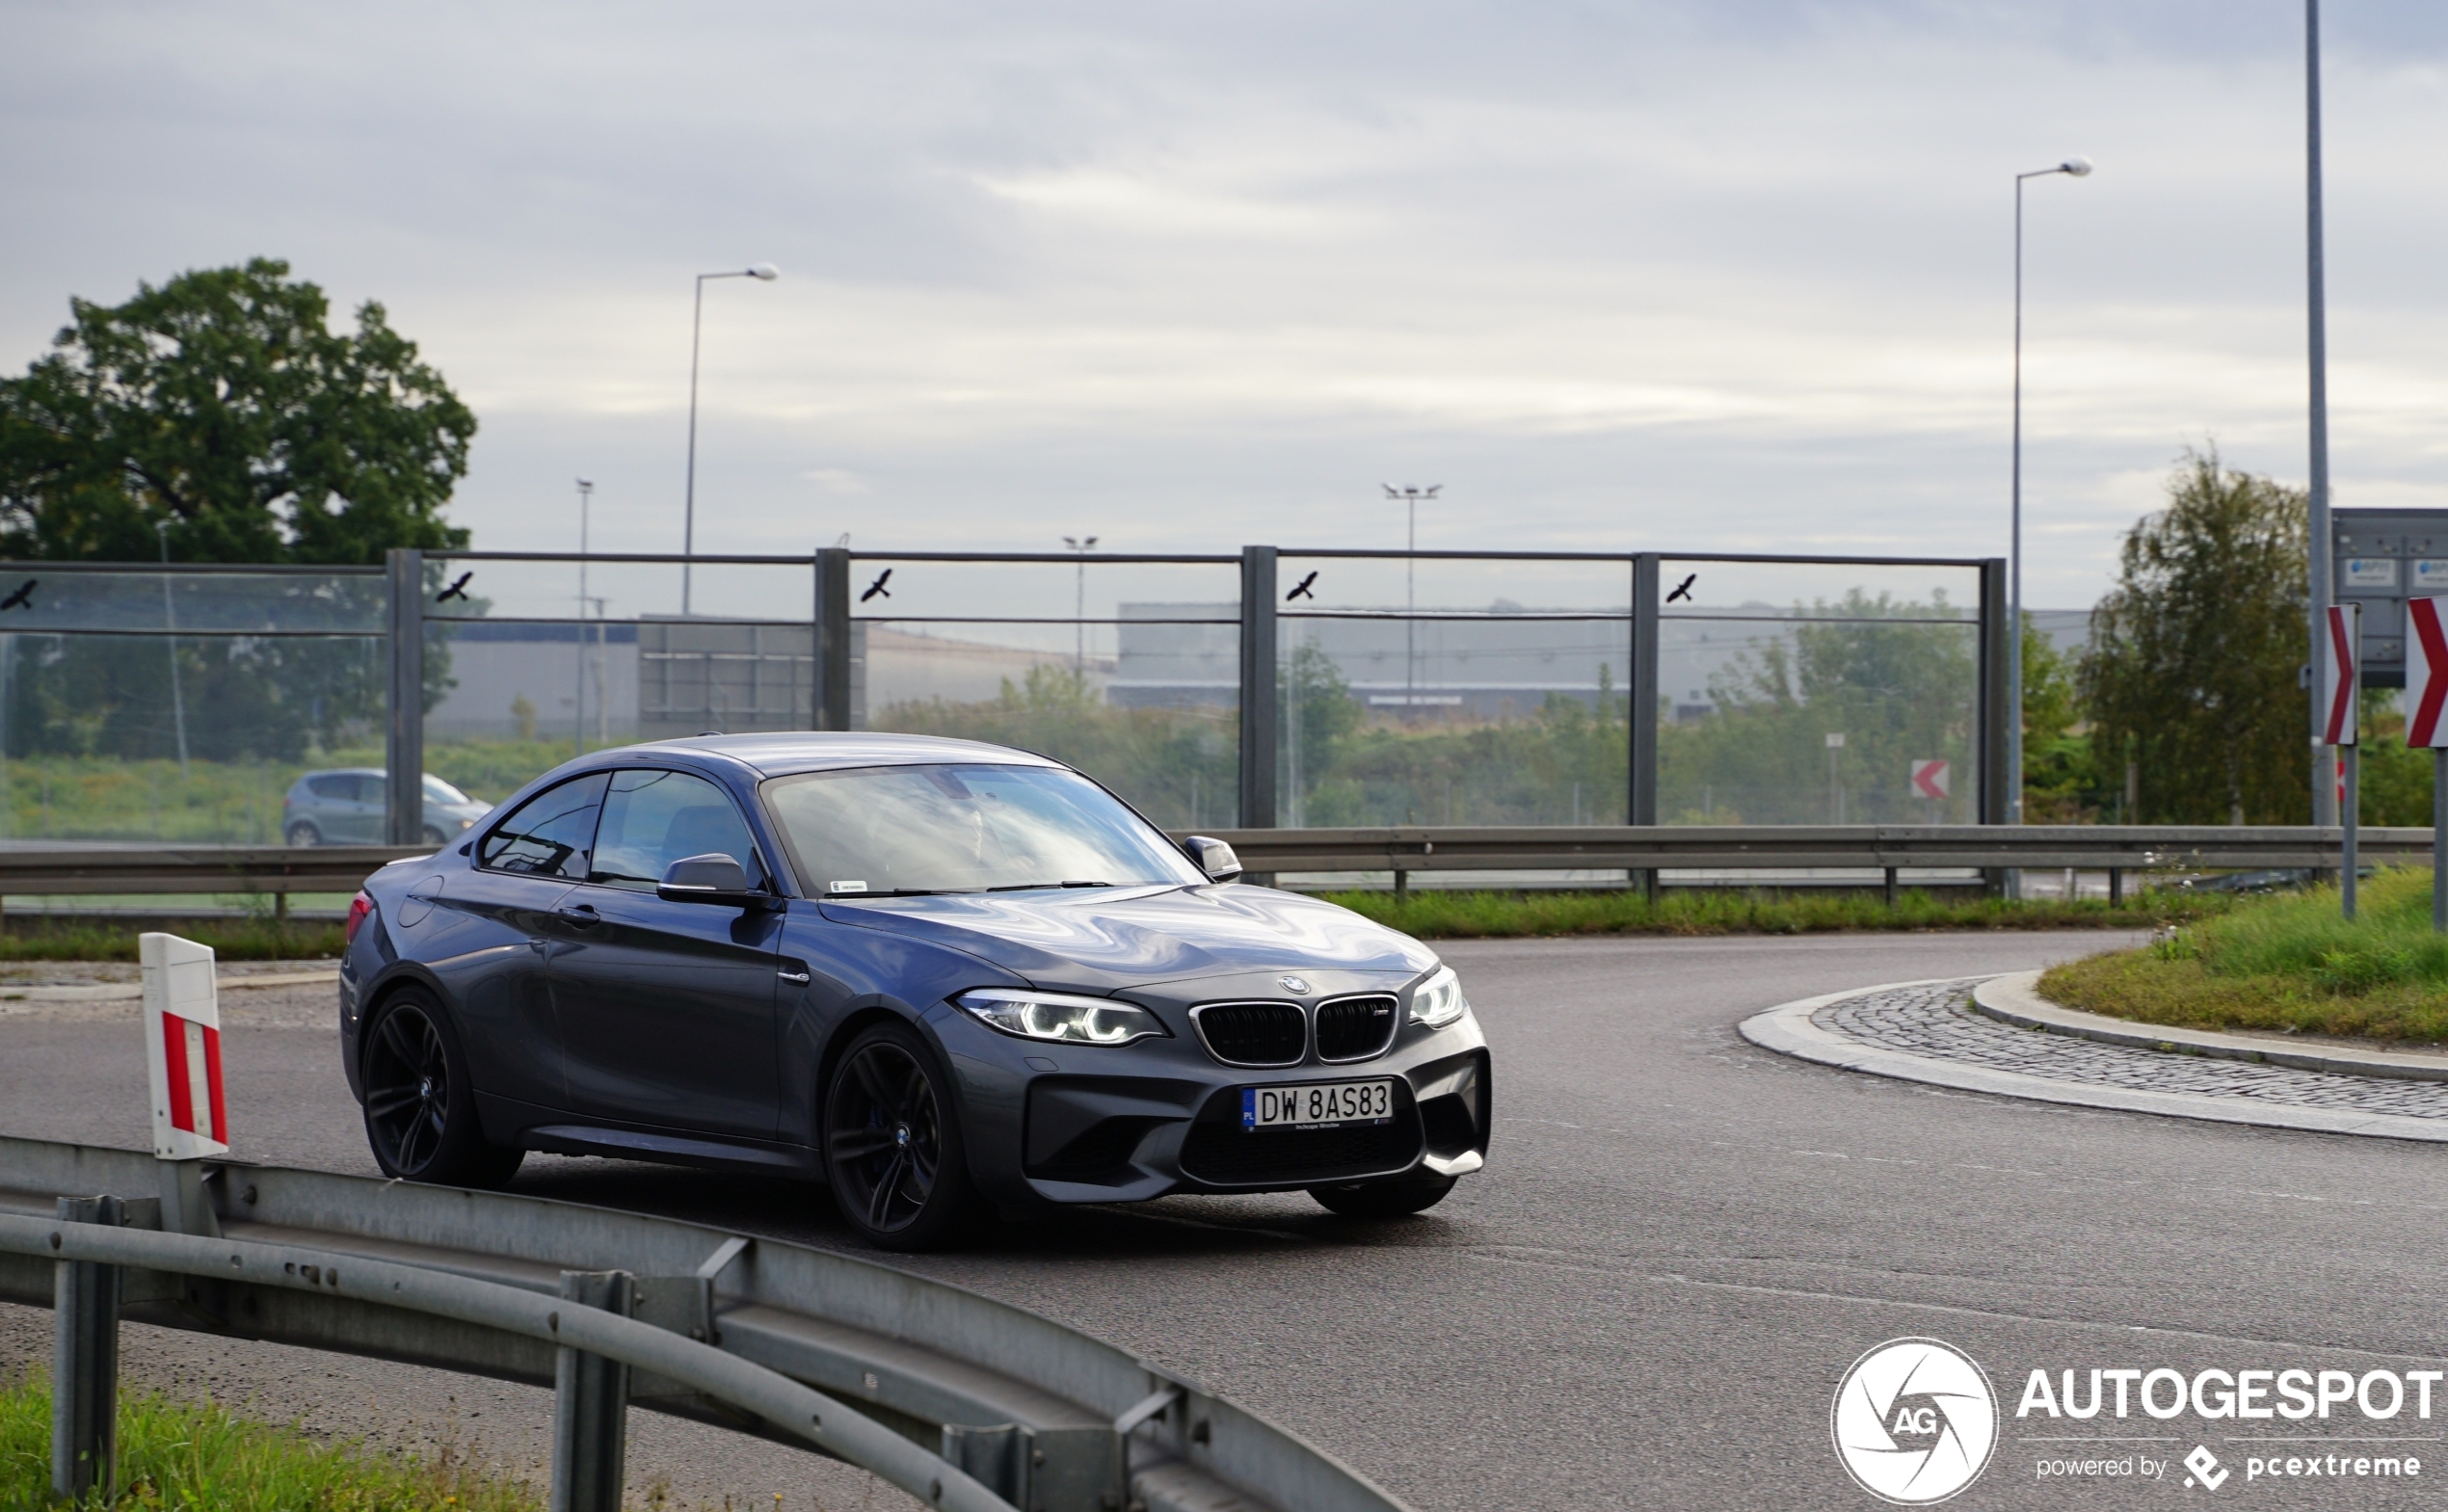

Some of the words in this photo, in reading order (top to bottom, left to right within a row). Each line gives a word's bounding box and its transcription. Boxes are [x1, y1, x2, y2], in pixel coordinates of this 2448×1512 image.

[1243, 1111, 1255, 1121] PL
[1262, 1090, 1298, 1123] DW
[1309, 1085, 1387, 1120] 8AS83
